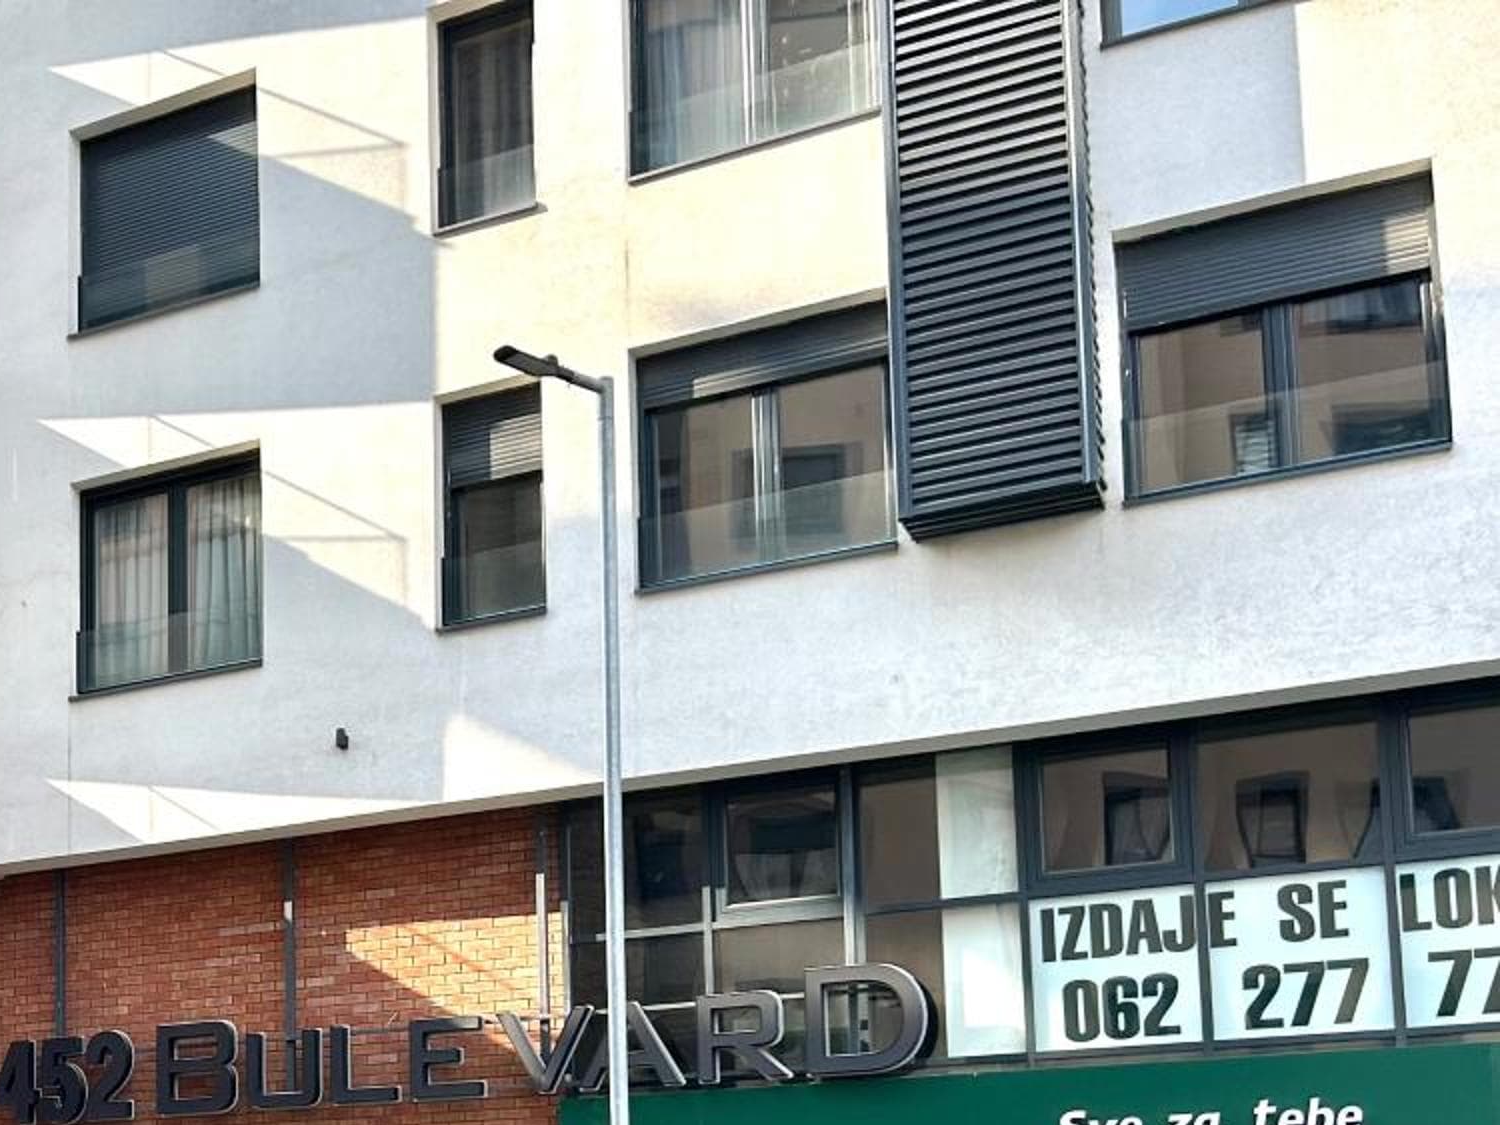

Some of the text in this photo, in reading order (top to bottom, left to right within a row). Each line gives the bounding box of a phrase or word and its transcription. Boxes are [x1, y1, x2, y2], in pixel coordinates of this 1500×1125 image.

[1040, 891, 1238, 963] IZDAJE
[1277, 880, 1350, 943] SE
[156, 963, 934, 1116] BULEVARD
[1061, 972, 1182, 1043] 062
[1242, 957, 1370, 1031] 277
